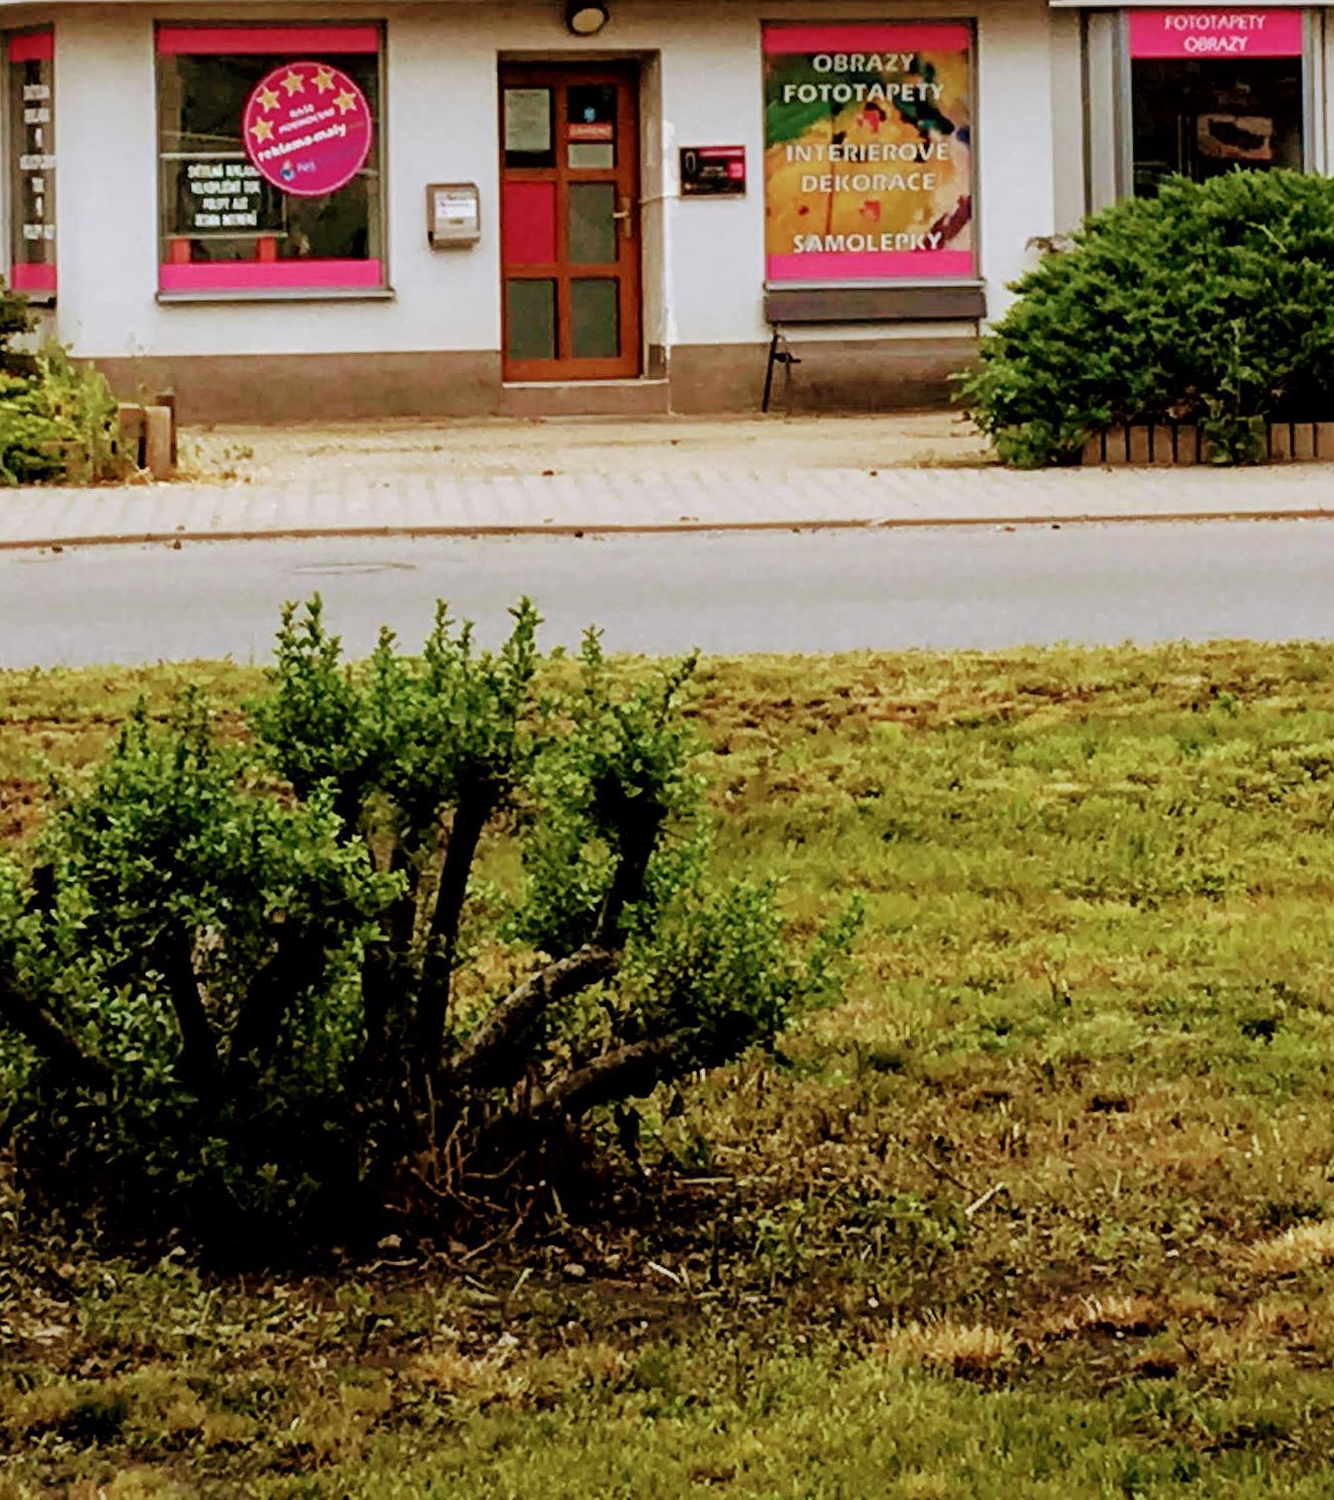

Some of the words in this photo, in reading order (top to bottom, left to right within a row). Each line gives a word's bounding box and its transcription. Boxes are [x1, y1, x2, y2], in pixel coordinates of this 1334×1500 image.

[1164, 14, 1267, 31] FOTOTAPETY
[1183, 36, 1249, 52] OBRAZY
[812, 53, 915, 73] OBRAZY
[783, 82, 945, 103] FOTOTAPETY
[801, 172, 937, 193] DEKORACE
[793, 232, 944, 254] SAMOLEPKY
